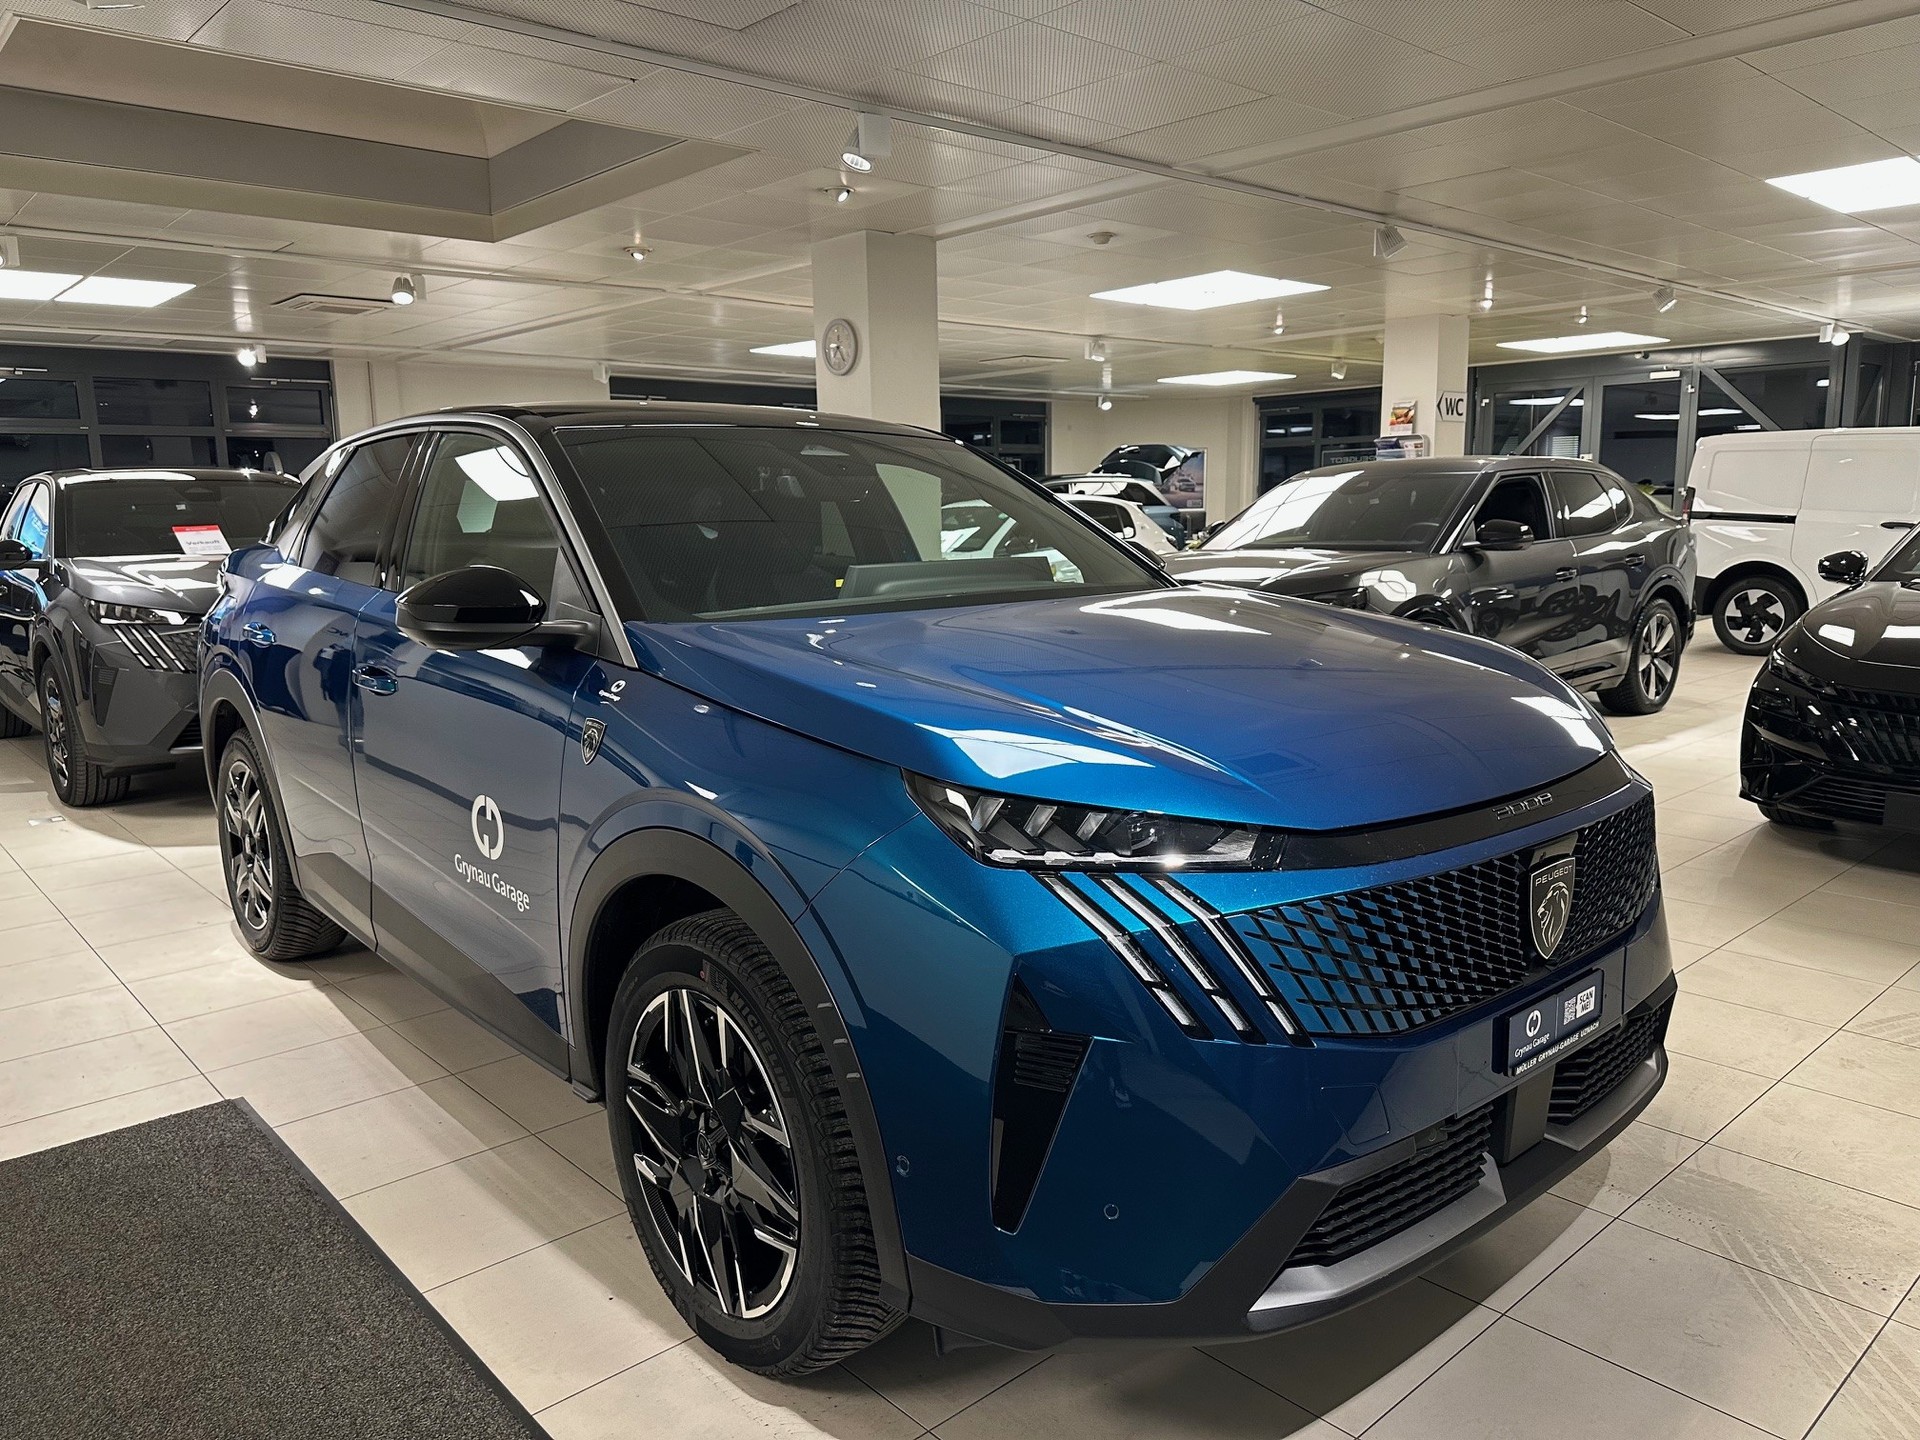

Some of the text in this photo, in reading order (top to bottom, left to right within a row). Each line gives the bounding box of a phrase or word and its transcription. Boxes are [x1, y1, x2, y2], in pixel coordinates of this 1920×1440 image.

[1445, 397, 1464, 416] WC
[454, 853, 530, 912] Grynau Garage
[1535, 864, 1573, 887] PEUGEOT
[1579, 989, 1594, 1005] SCAN
[1514, 1032, 1550, 1058] Grynau Garage
